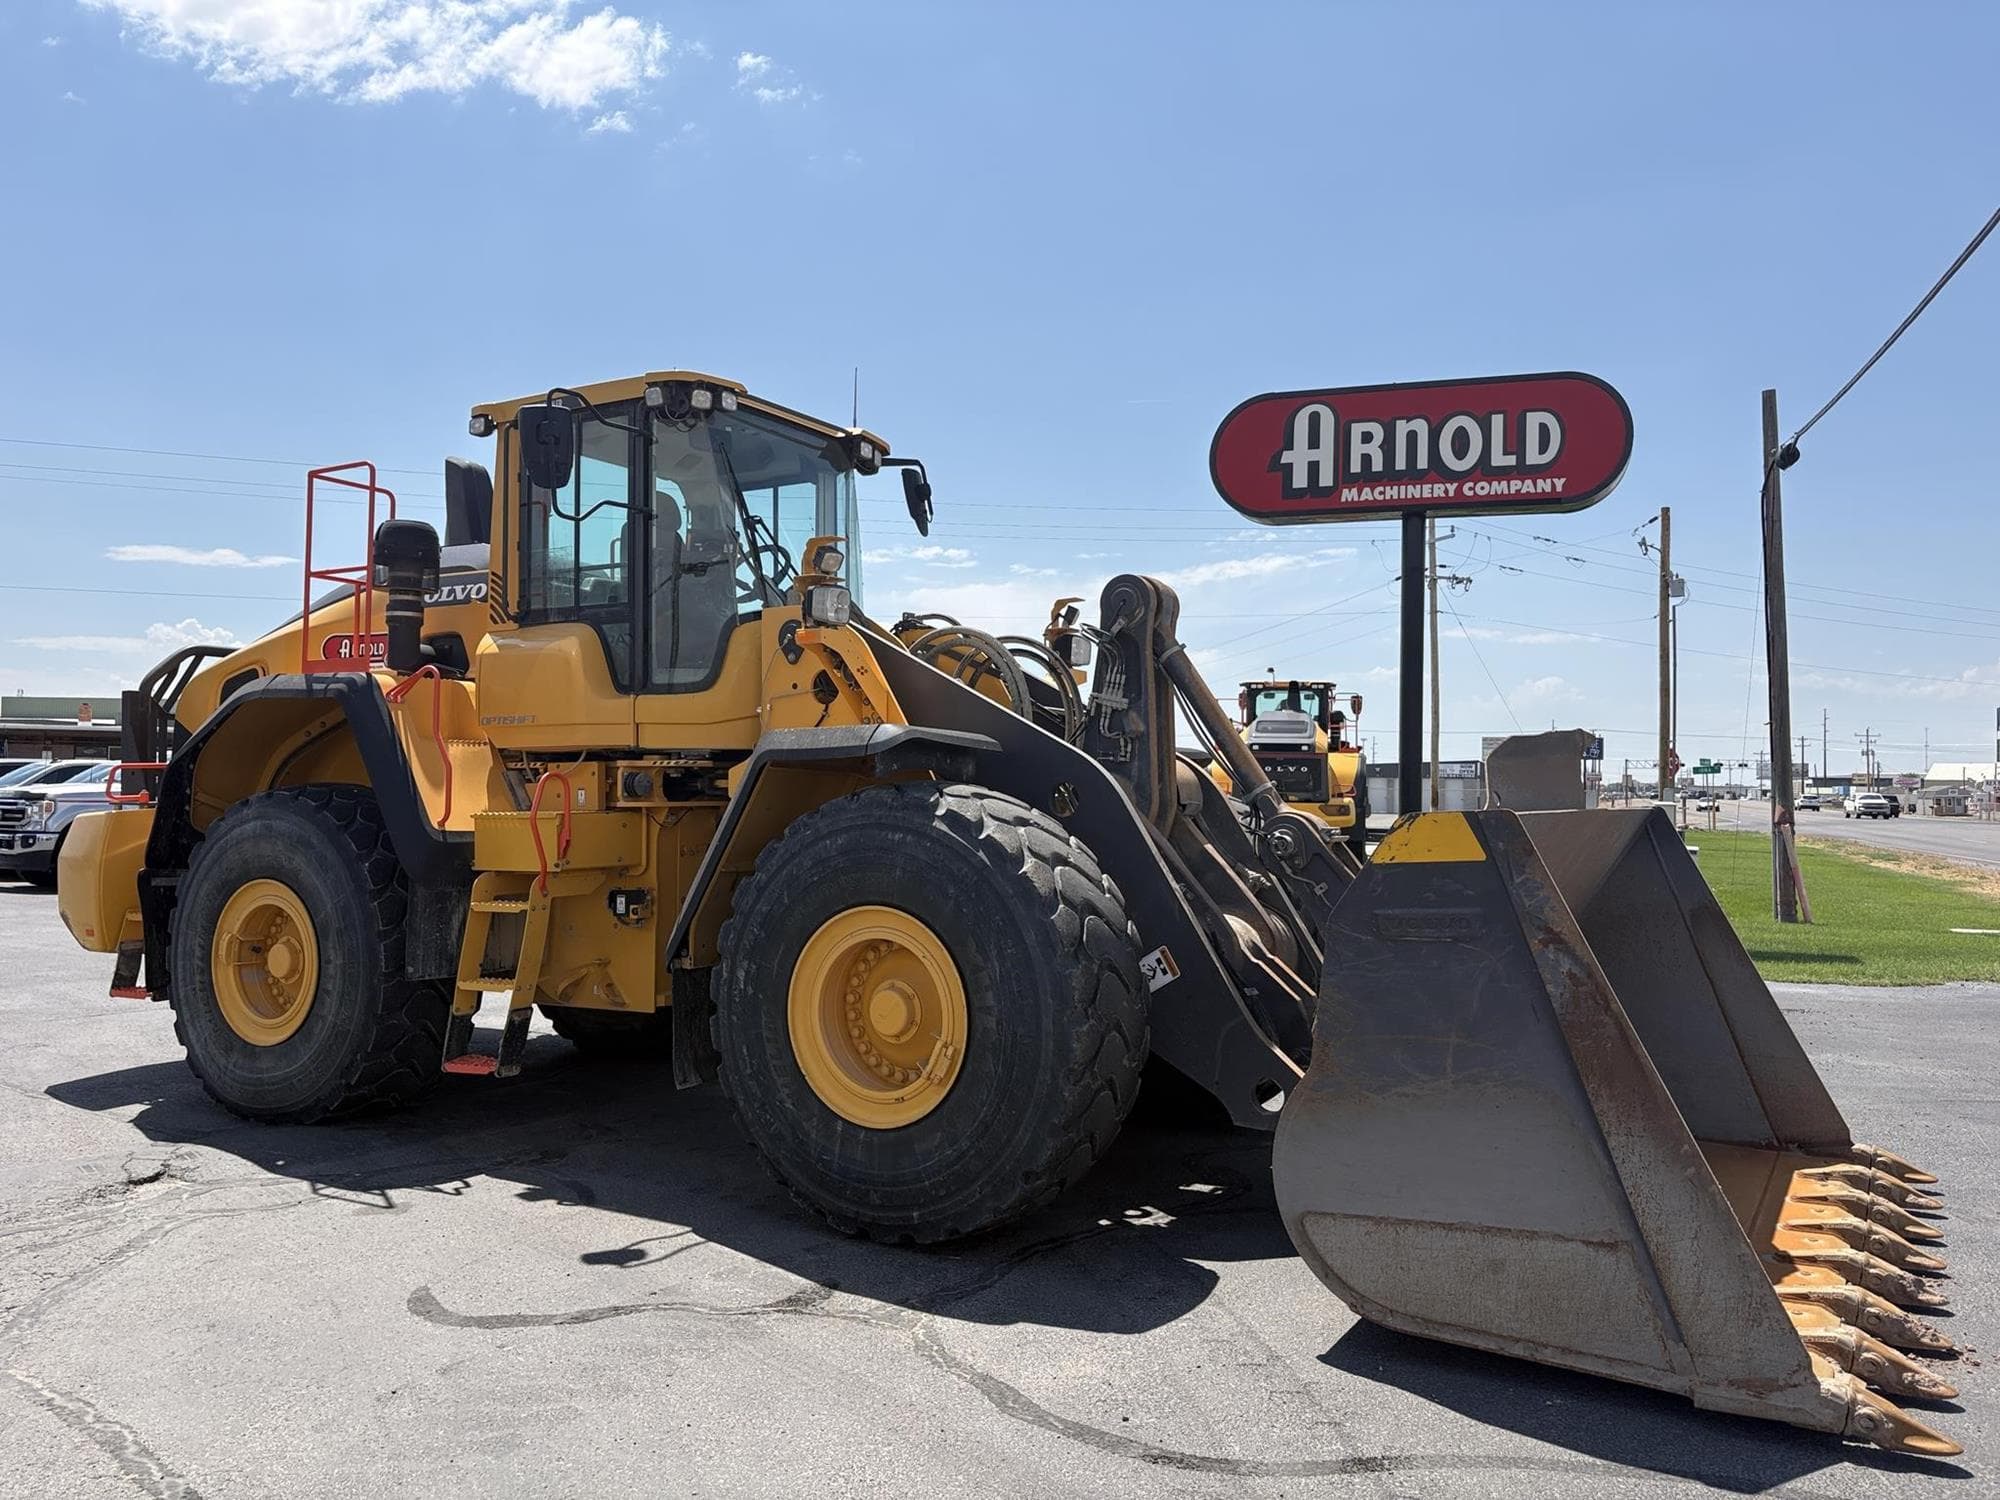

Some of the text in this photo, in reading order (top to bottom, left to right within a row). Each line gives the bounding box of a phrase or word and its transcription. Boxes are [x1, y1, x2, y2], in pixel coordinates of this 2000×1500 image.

[1275, 403, 1563, 492] ARNOLD
[1341, 478, 1567, 502] MACHINERY COMPANY
[424, 583, 487, 603] OLVO
[339, 639, 385, 658] ANOLD
[480, 714, 537, 726] OPTISHIFT
[1264, 765, 1309, 773] OLVO
